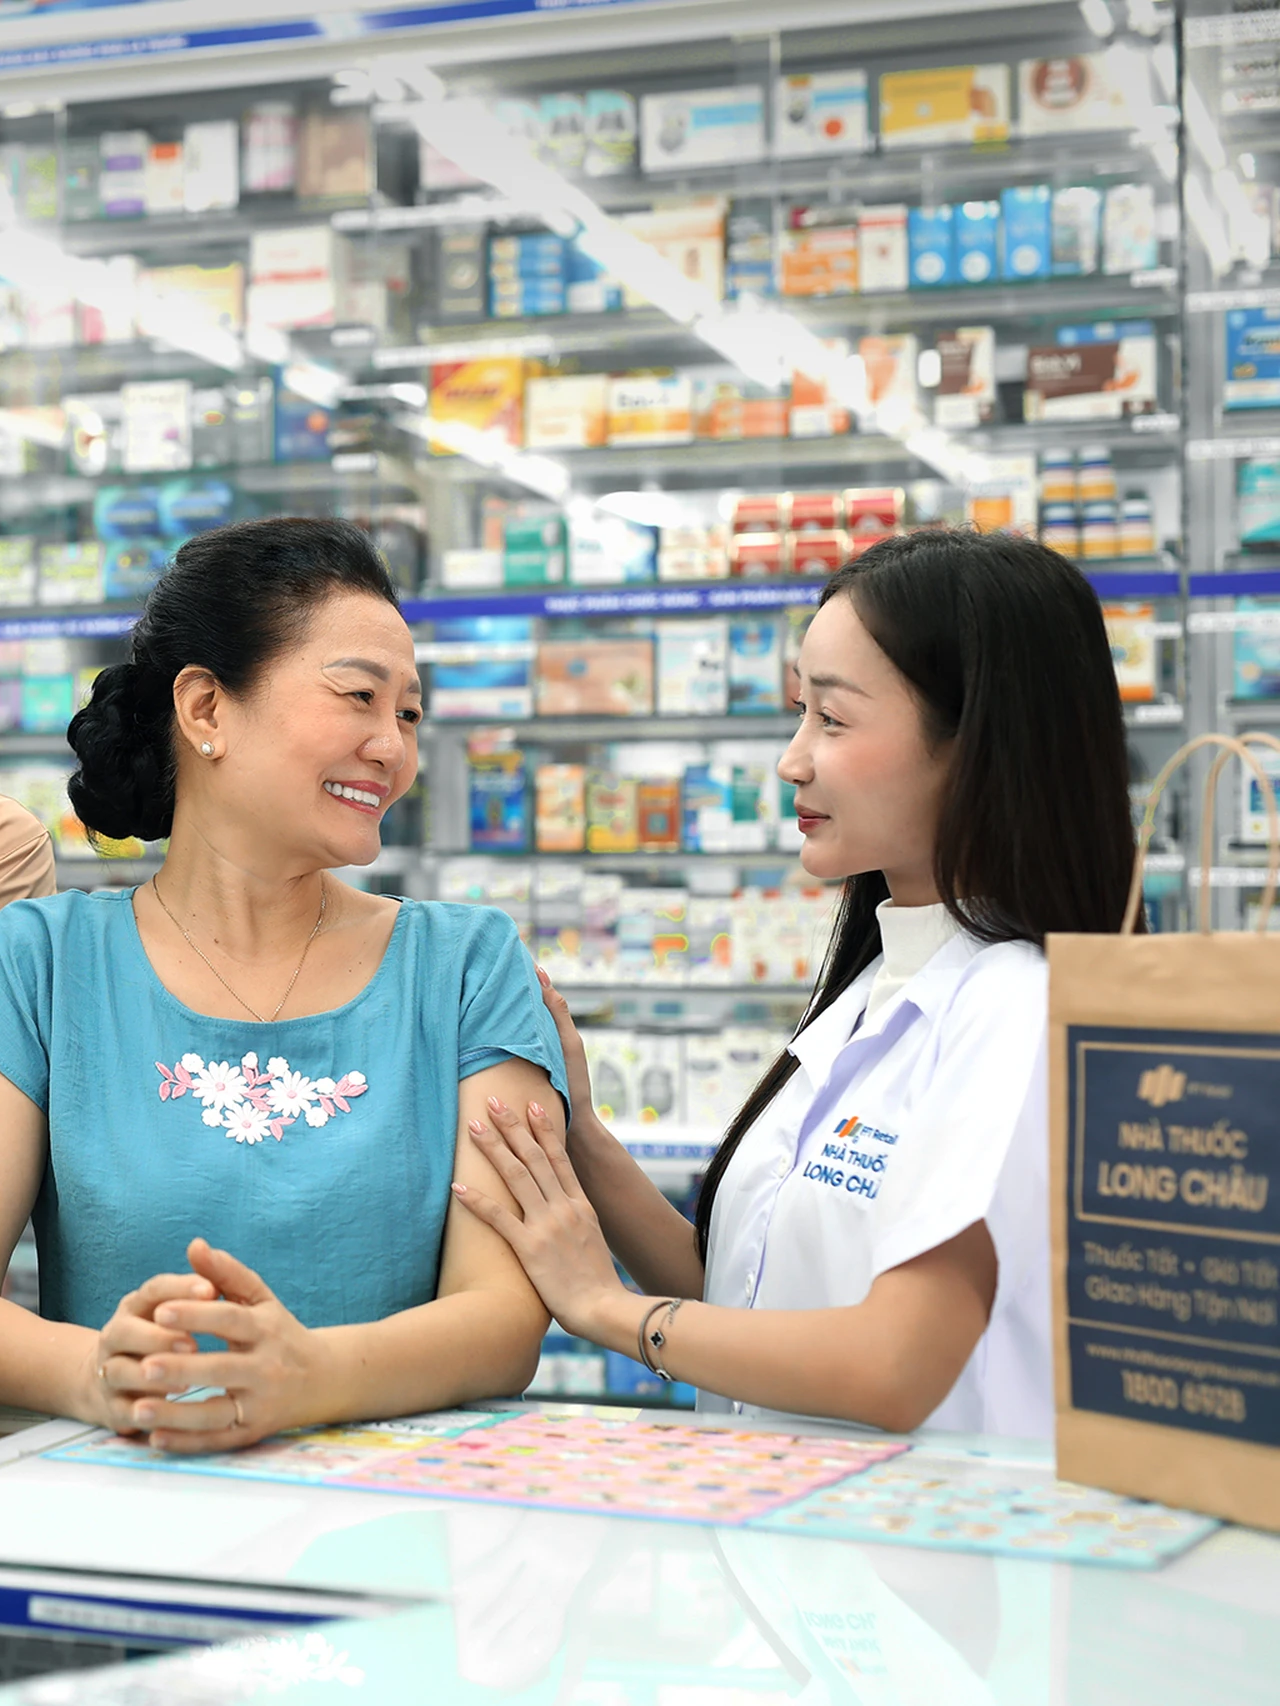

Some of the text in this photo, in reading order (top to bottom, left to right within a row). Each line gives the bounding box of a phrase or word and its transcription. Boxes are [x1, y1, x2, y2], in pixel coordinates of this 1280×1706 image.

[821, 1143, 847, 1161] NHÀ
[1118, 1117, 1249, 1160] NHÀ THUỐC
[803, 1161, 844, 1187] LONG
[1096, 1161, 1269, 1213] LONG CHÂU
[1083, 1241, 1145, 1272] Thuốc
[1084, 1274, 1136, 1305] Giao
[1136, 1281, 1192, 1323] Hàng
[1122, 1369, 1247, 1423] 1800 6928
